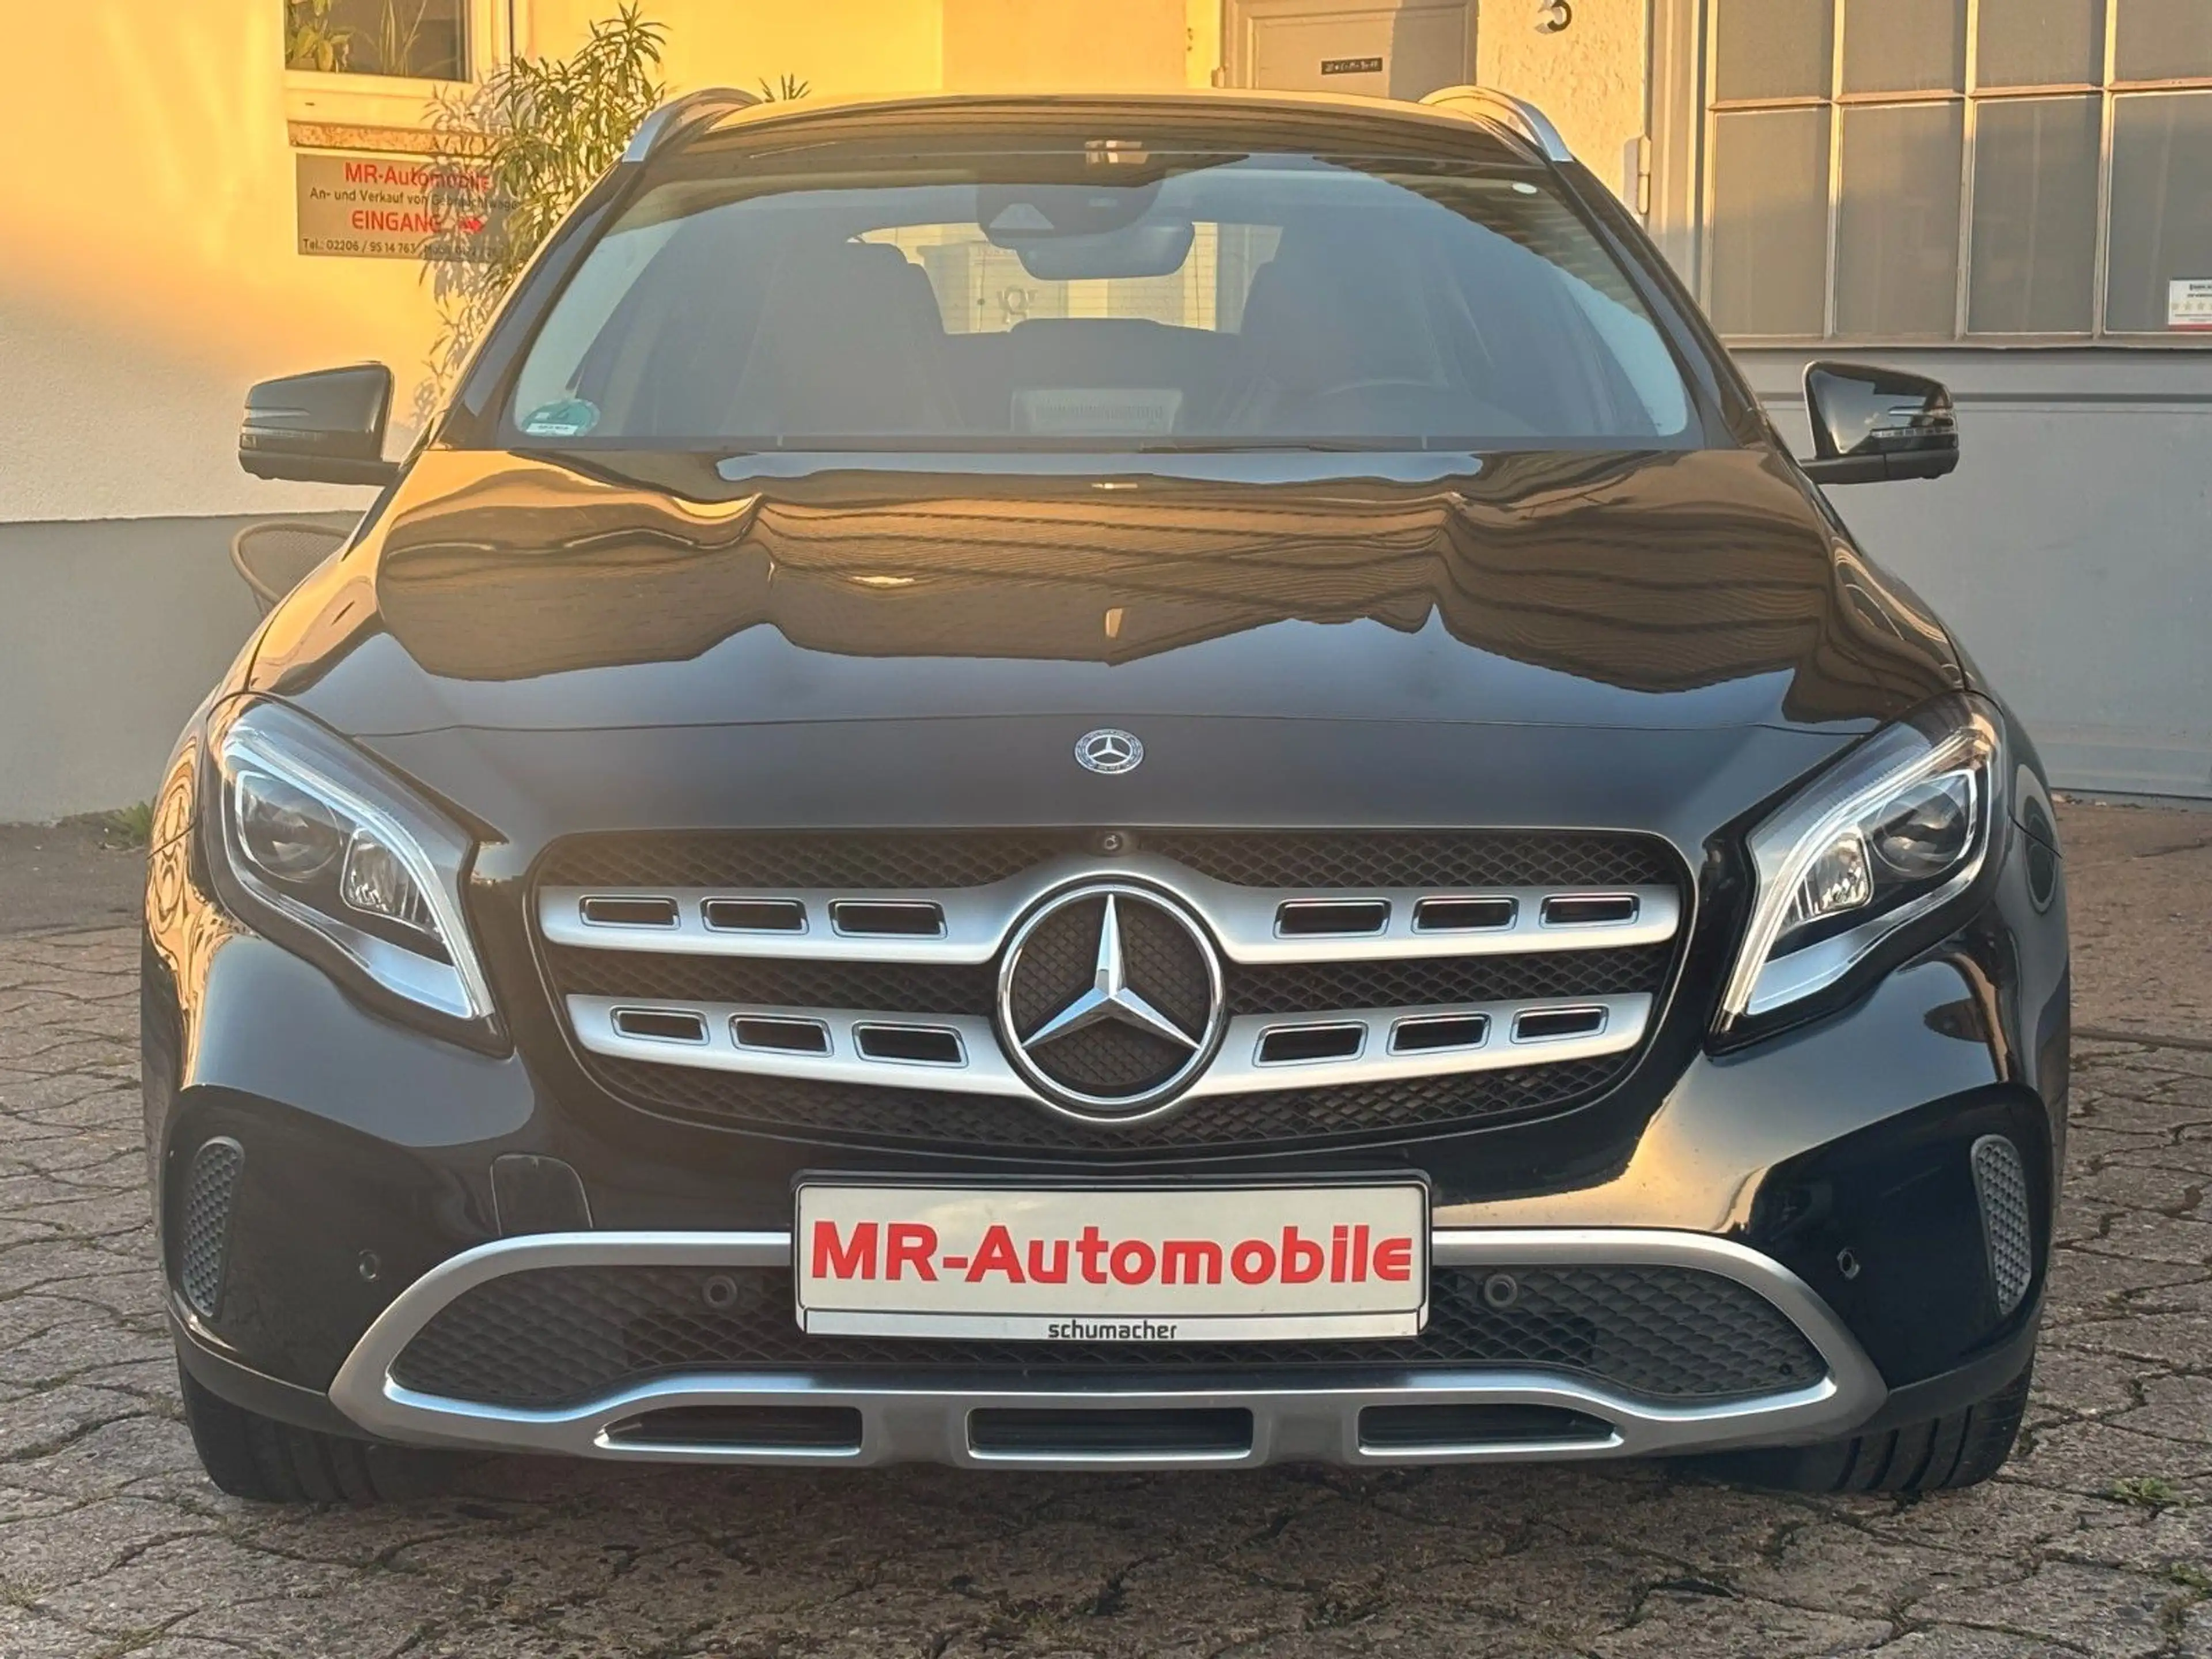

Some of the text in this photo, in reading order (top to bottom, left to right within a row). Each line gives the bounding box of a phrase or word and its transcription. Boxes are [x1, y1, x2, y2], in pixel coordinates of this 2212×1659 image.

[310, 187, 331, 199] An-
[334, 190, 356, 201] und
[359, 190, 404, 202] Verkauf
[352, 210, 441, 233] EINGANG
[326, 239, 359, 252] 02206
[385, 242, 395, 253] 14
[812, 1221, 1412, 1285] MR-Automobile
[1048, 1318, 1177, 1339] schumacher
